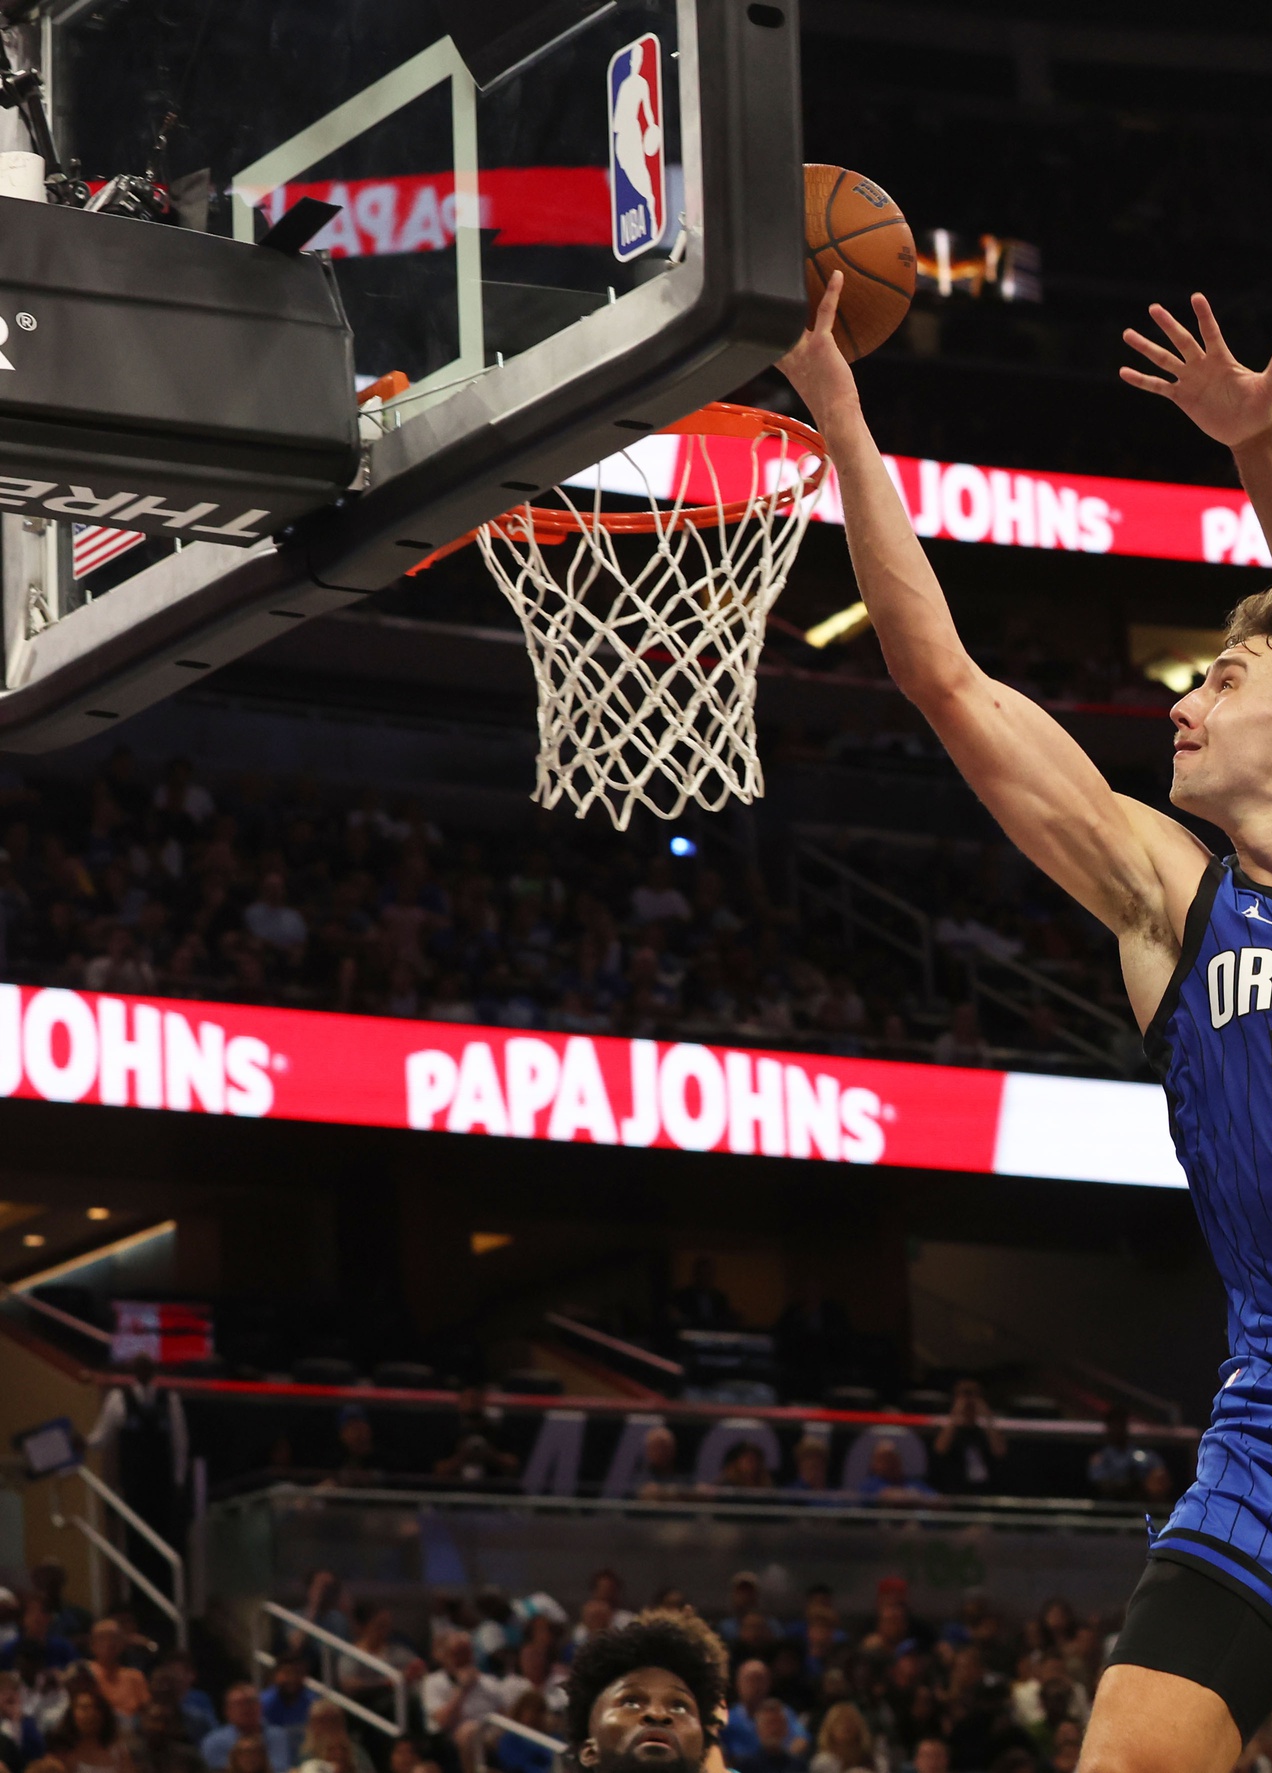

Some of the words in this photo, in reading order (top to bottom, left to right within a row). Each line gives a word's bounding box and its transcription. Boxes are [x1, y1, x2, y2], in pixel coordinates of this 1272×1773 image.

[620, 203, 647, 247] NBA
[915, 459, 1114, 553] JOHNS
[405, 1036, 619, 1145] PAPA
[620, 1038, 886, 1165] JOHNS
